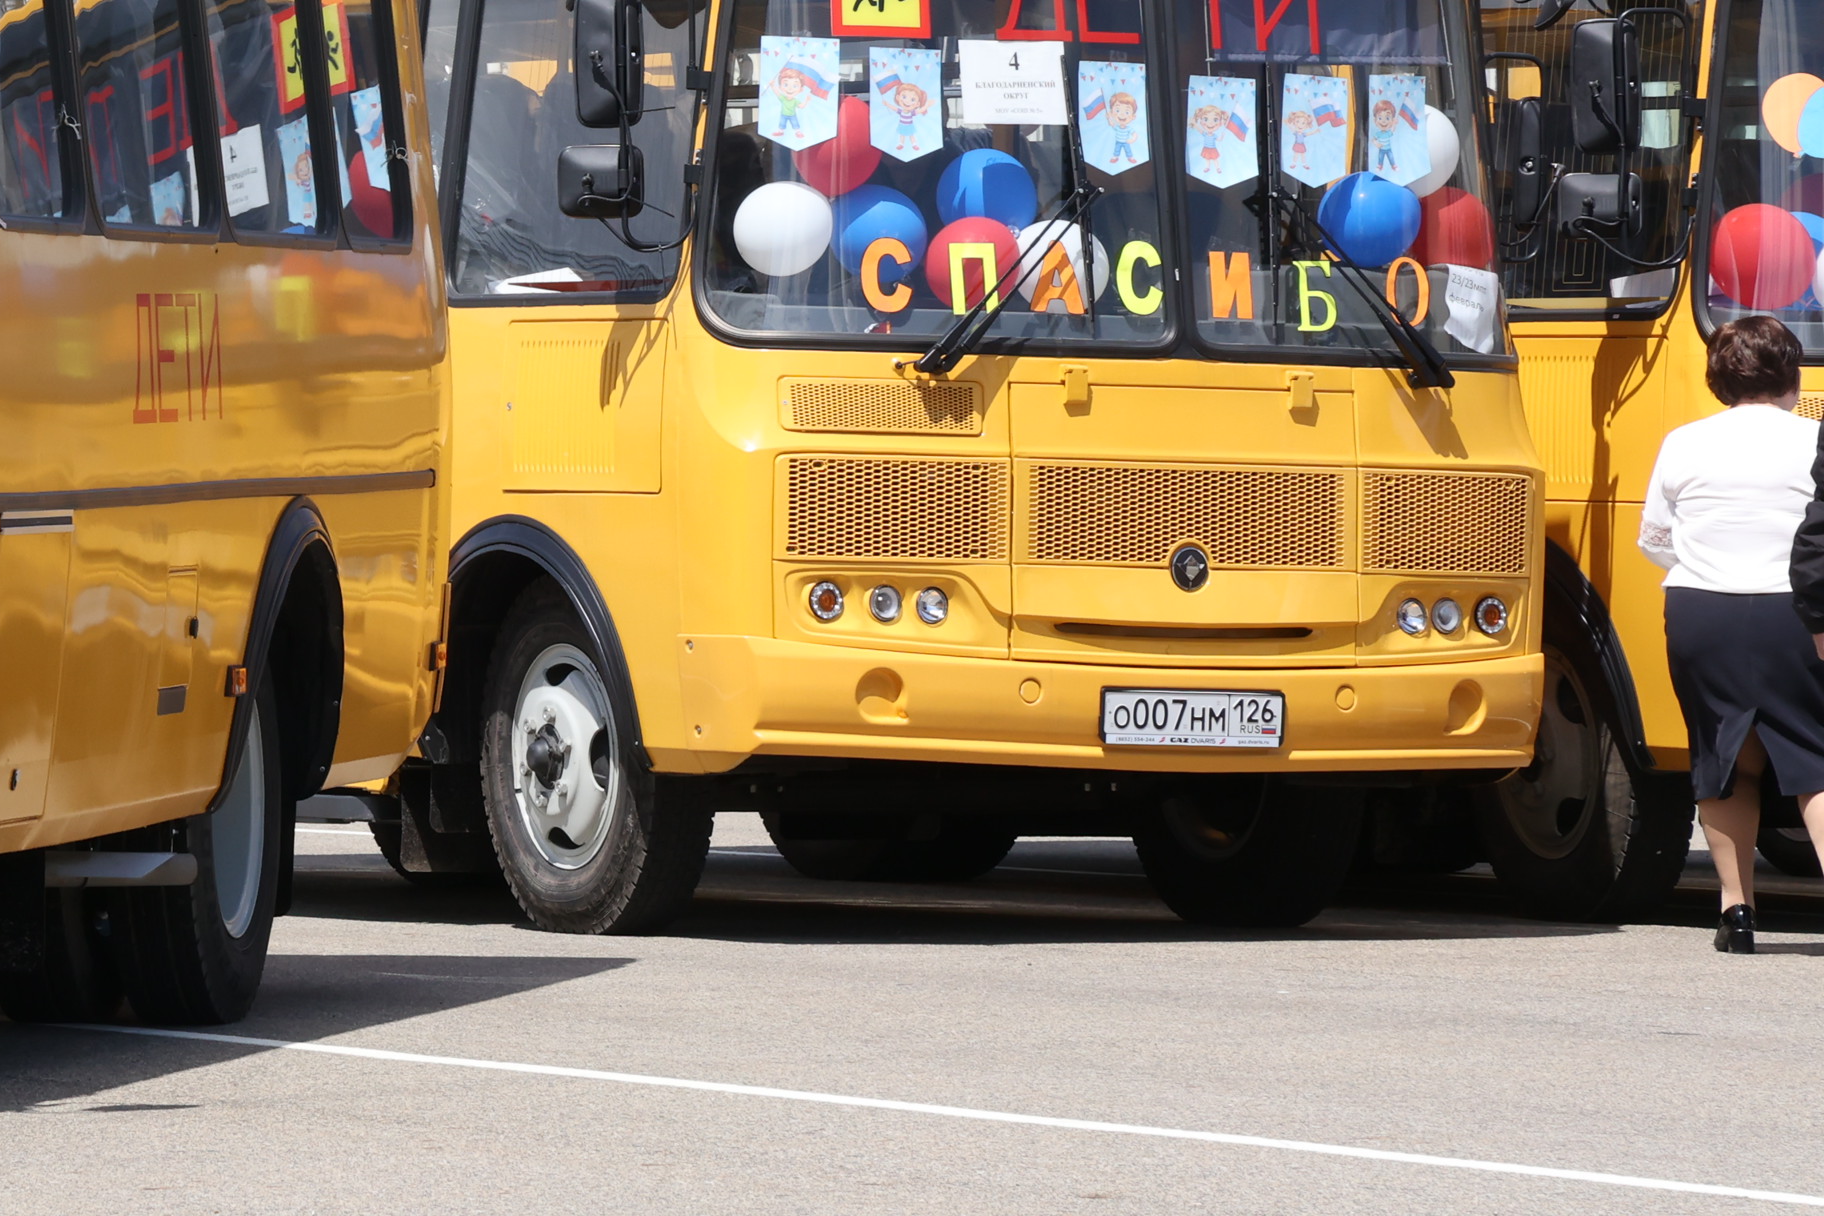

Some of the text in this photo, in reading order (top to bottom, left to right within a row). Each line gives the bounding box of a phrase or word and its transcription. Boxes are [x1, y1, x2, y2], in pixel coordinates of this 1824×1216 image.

[1008, 51, 1020, 71] 4
[1003, 92, 1029, 100] ОКРУГ
[133, 293, 223, 424] ДЕТИ
[1233, 698, 1275, 723] 126
[1240, 724, 1261, 734] RUS
